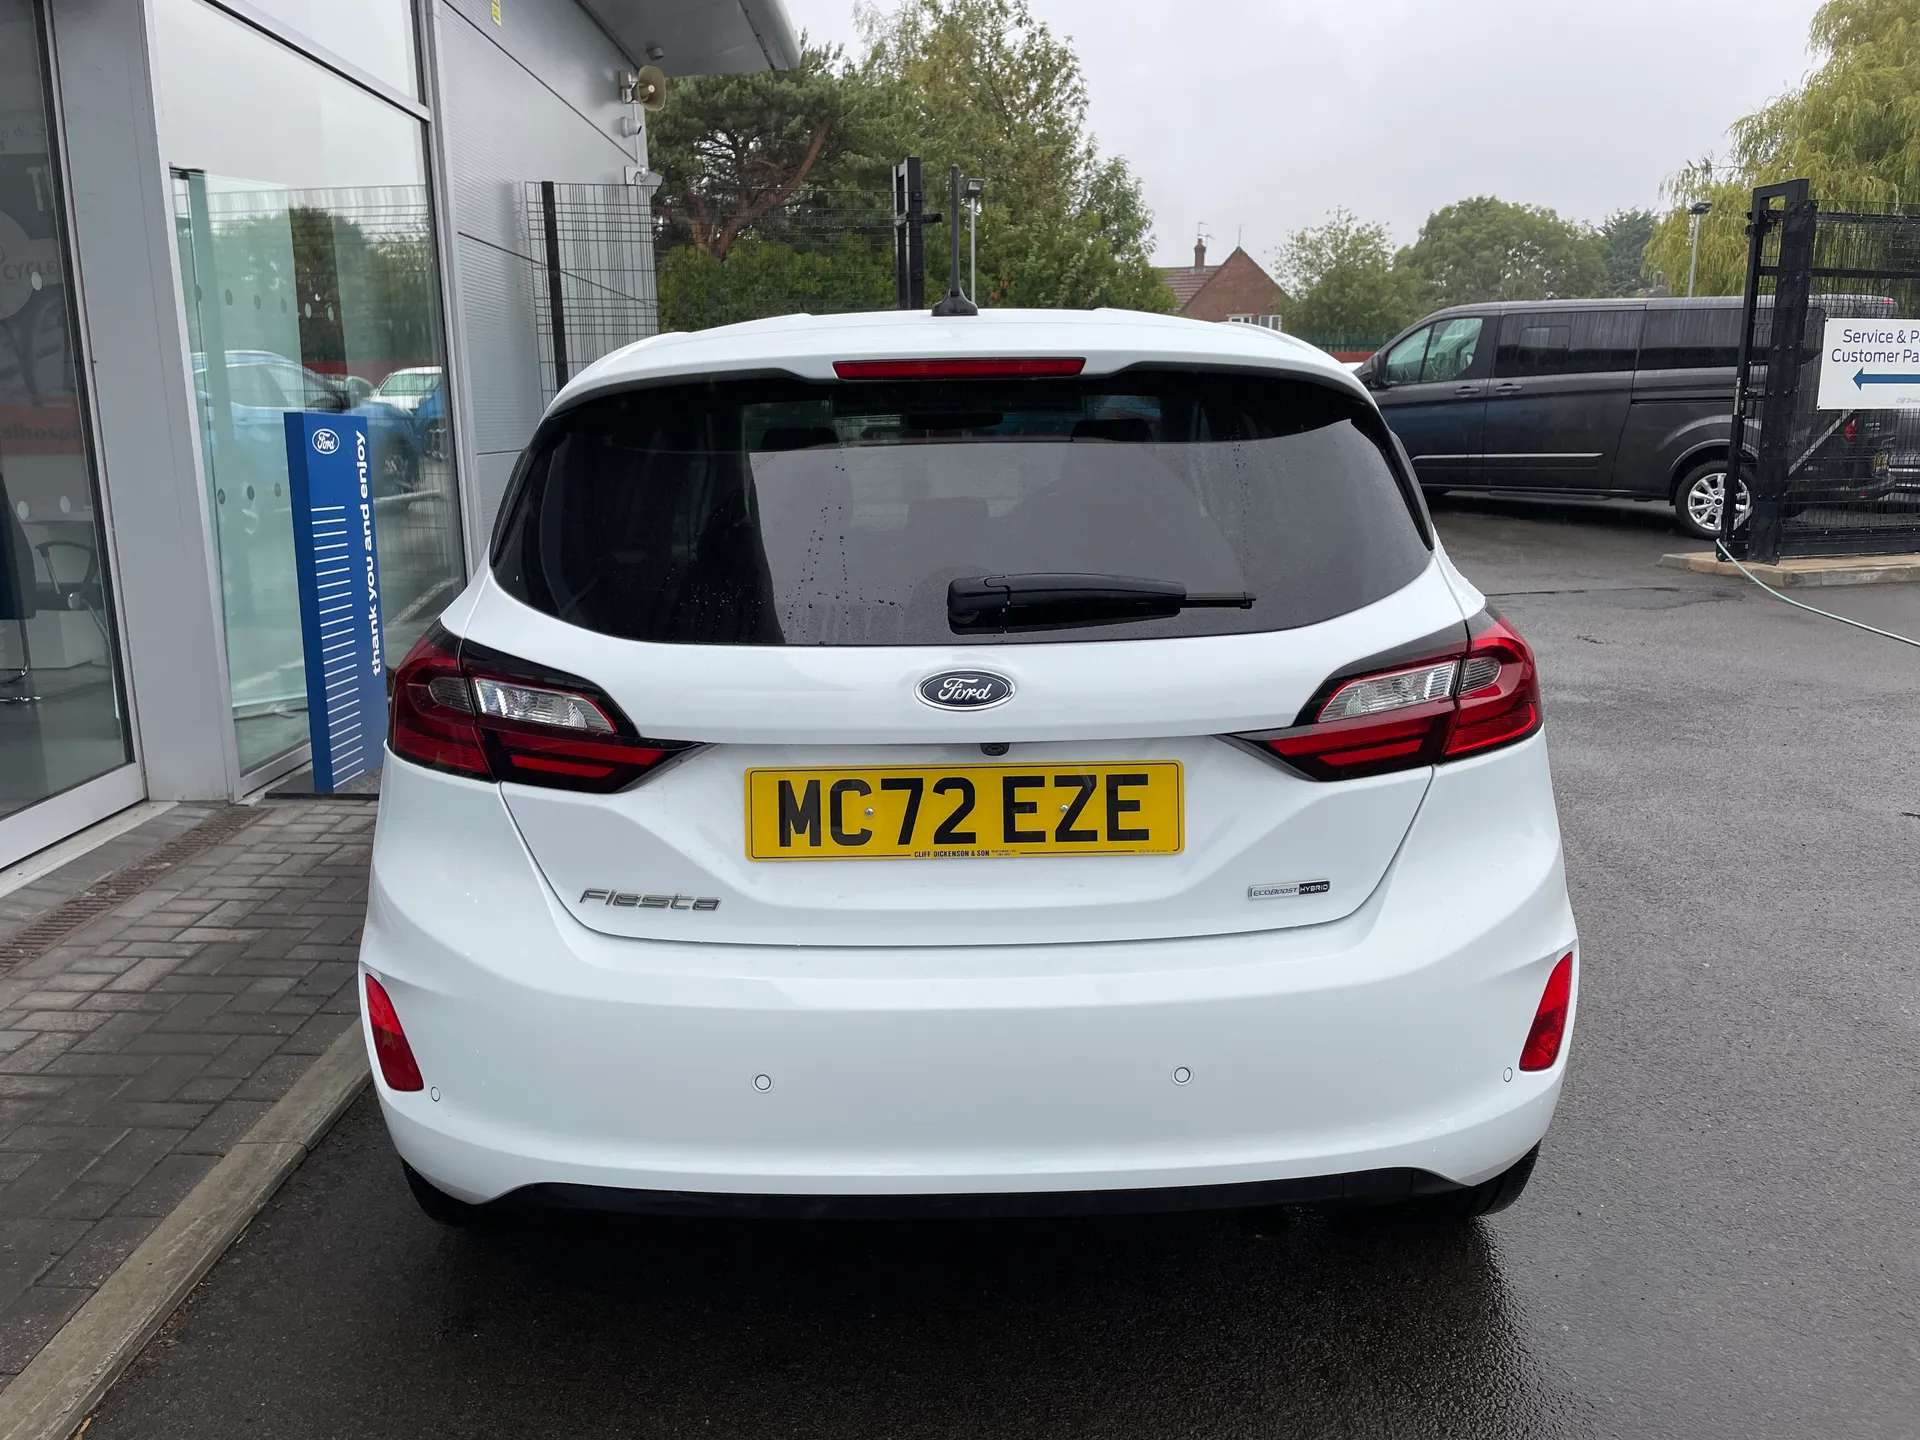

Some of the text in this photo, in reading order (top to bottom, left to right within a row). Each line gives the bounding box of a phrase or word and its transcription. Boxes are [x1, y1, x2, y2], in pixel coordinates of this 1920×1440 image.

[1842, 329, 1920, 344] Service & P
[1831, 348, 1900, 363] Customer
[356, 429, 380, 677] thank you and enjoy
[937, 677, 993, 701] Ford
[778, 773, 1150, 848] MC72 EZE
[914, 850, 931, 858] CLIFF
[933, 850, 970, 858] DICKENSON
[976, 849, 990, 857] SON
[1300, 883, 1329, 893] HYBRID
[579, 887, 721, 912] Fiesta
